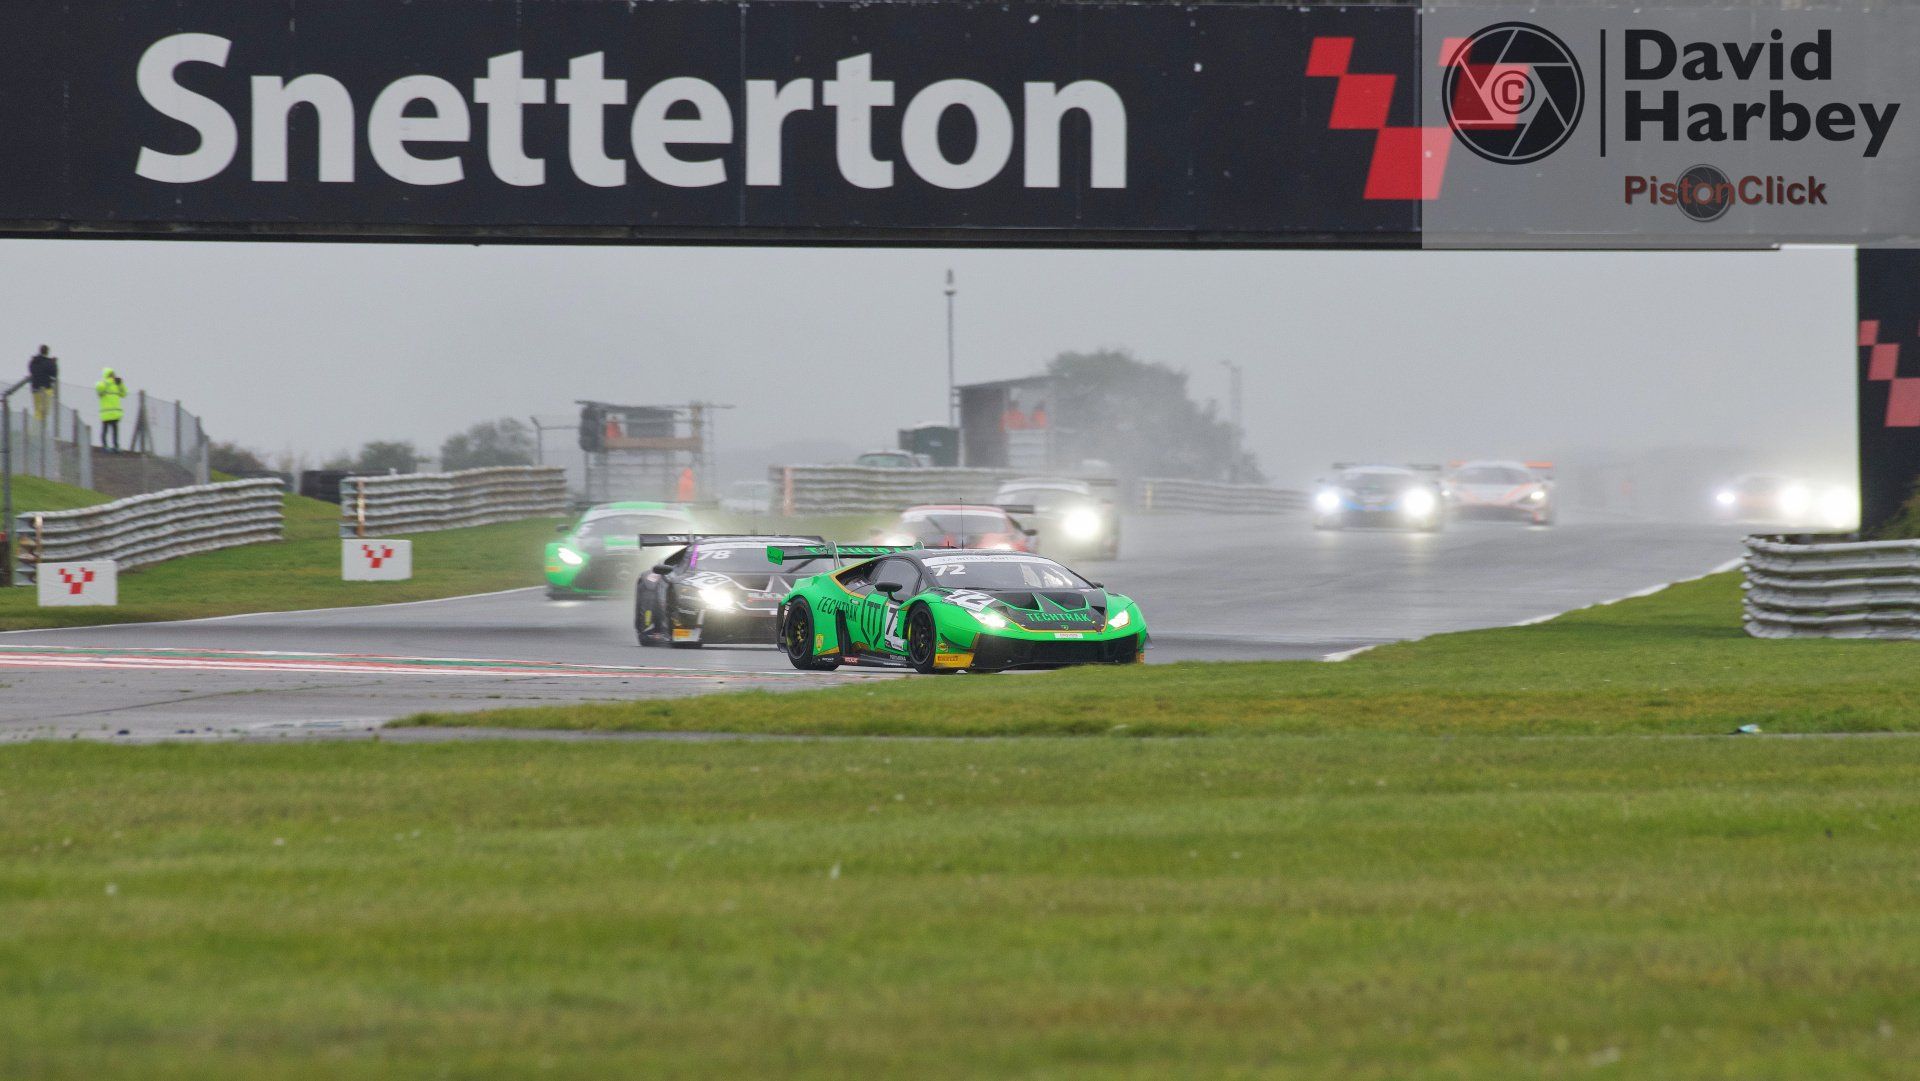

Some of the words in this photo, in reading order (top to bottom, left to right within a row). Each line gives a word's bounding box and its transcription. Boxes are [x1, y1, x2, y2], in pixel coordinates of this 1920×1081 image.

[136, 32, 1128, 190] Snetterton
[697, 550, 733, 560] 78
[931, 564, 967, 577] 72
[1025, 613, 1092, 623] TECHTRAK
